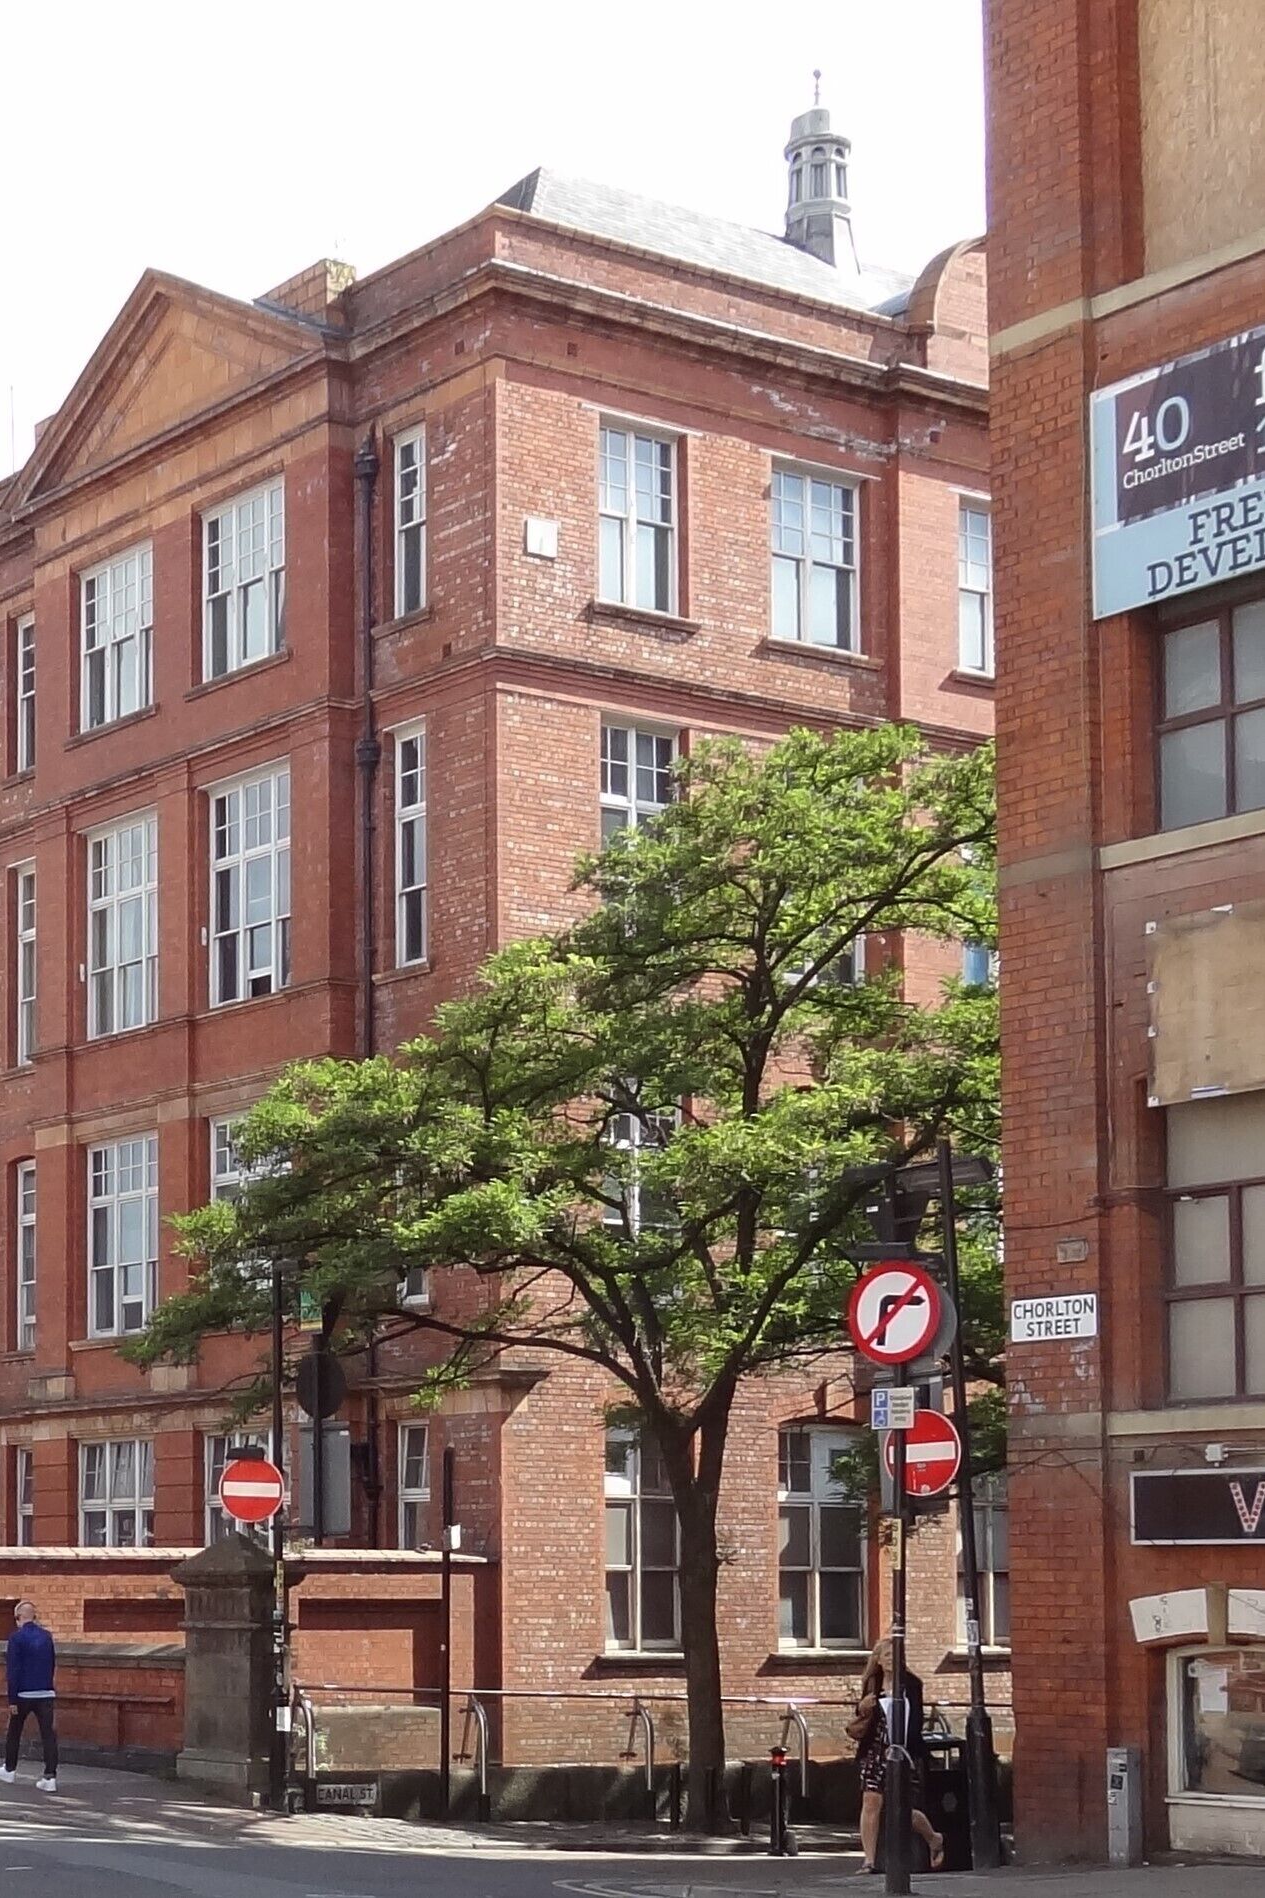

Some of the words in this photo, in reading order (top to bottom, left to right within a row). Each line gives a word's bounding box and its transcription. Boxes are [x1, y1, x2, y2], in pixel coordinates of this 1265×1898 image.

[1122, 395, 1190, 463] 40
[1188, 491, 1265, 546] FRE
[1014, 1297, 1094, 1320] CHORLTON
[1026, 1318, 1081, 1337] STREET
[876, 1392, 885, 1407] P
[318, 1788, 356, 1801] CANAL
